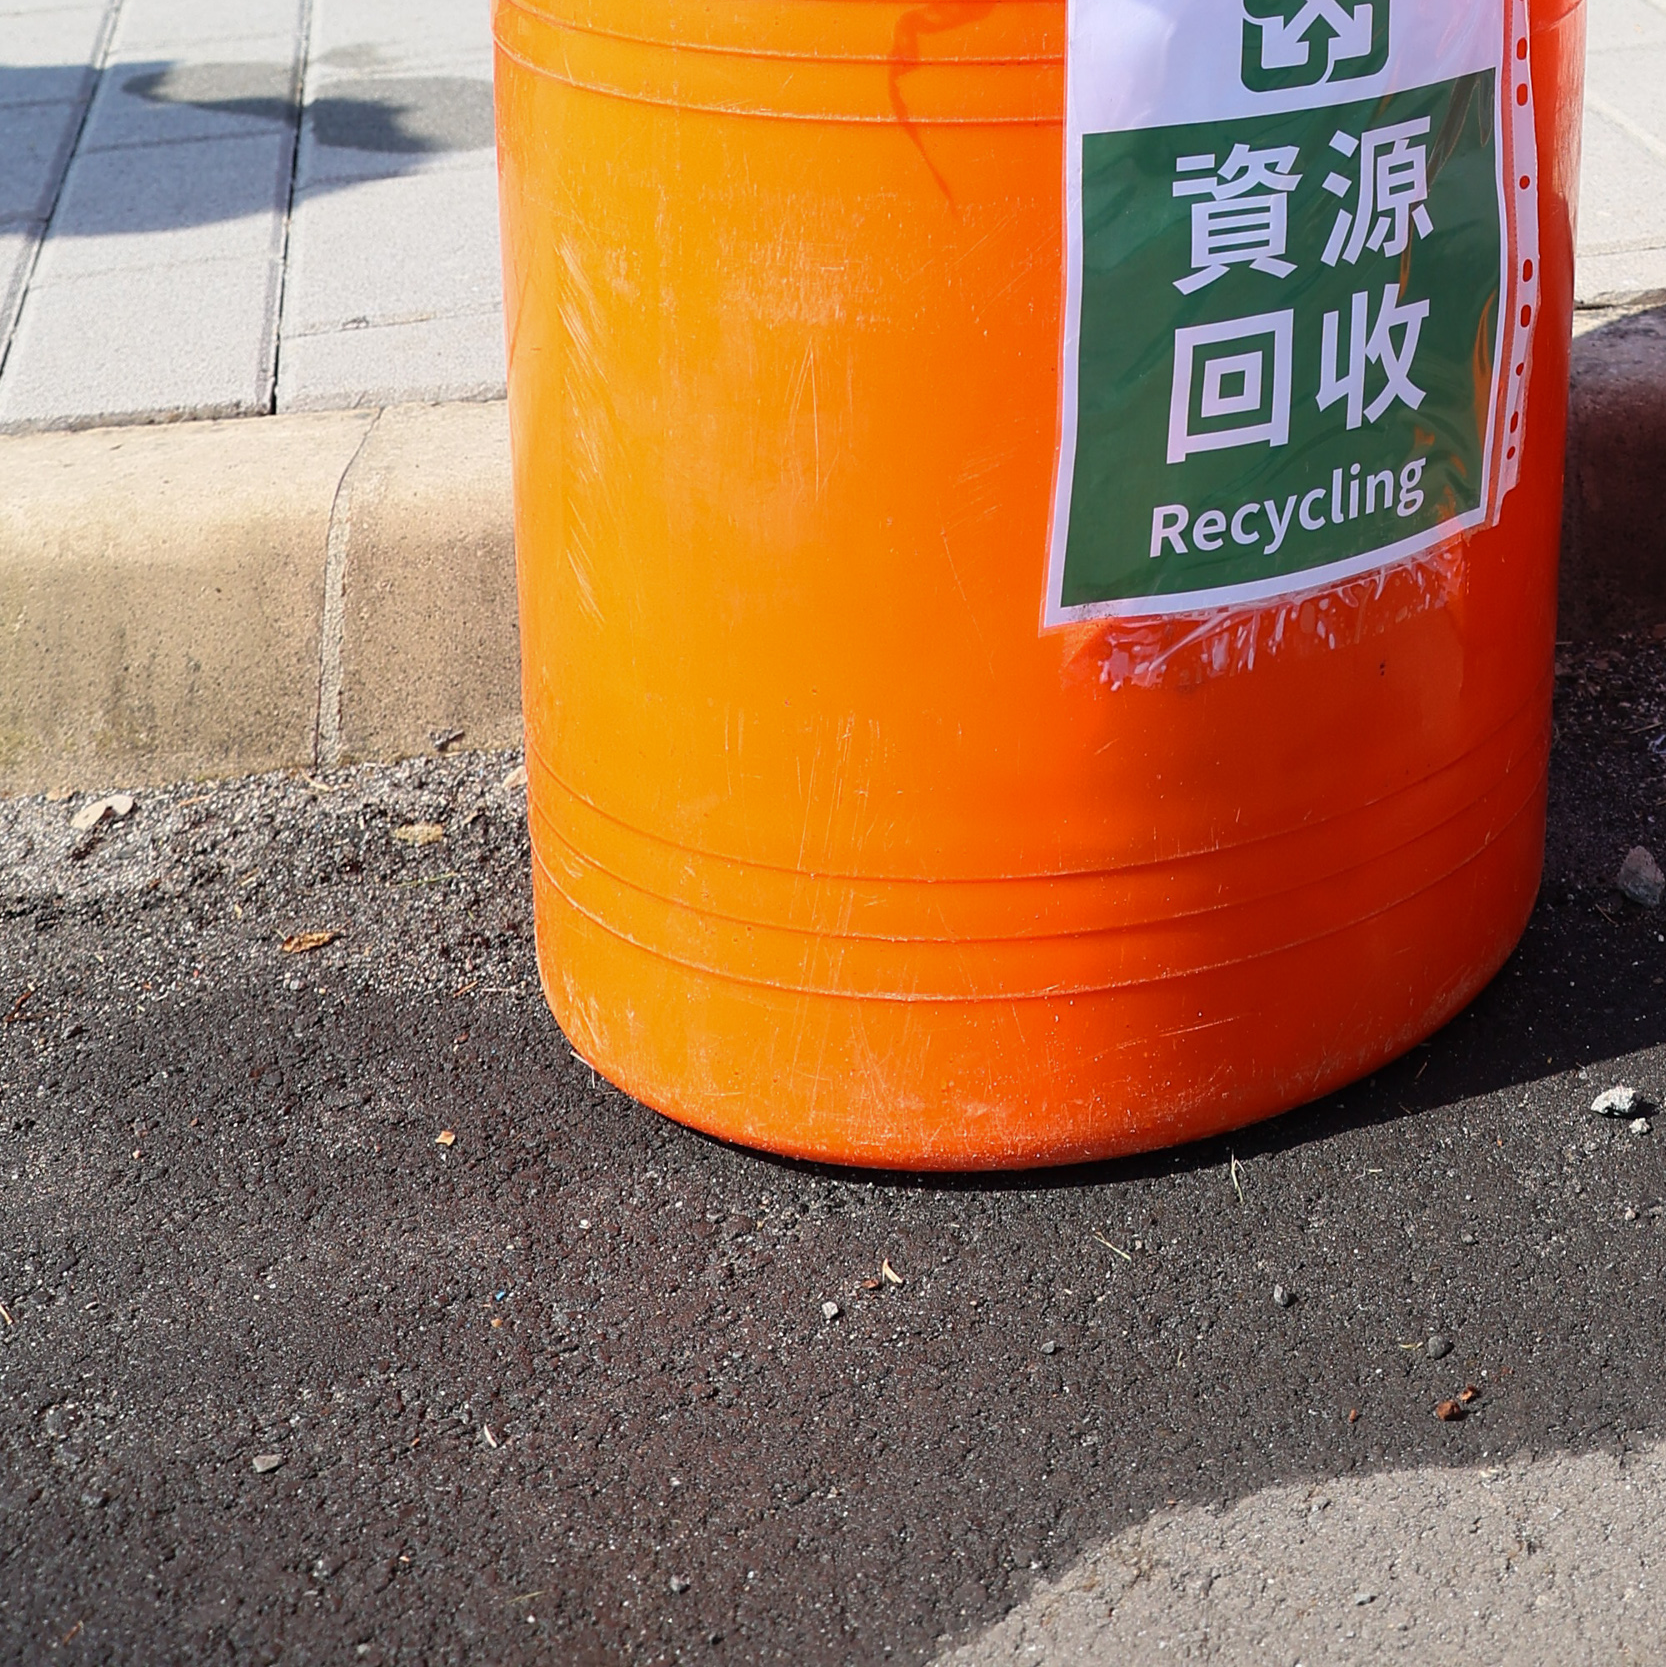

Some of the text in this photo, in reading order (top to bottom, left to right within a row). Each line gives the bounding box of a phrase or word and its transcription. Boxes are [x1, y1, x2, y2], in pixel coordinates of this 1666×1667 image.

[1174, 116, 1433, 294] 資源
[1167, 285, 1429, 464] 回收
[1150, 456, 1427, 557] Recycling
